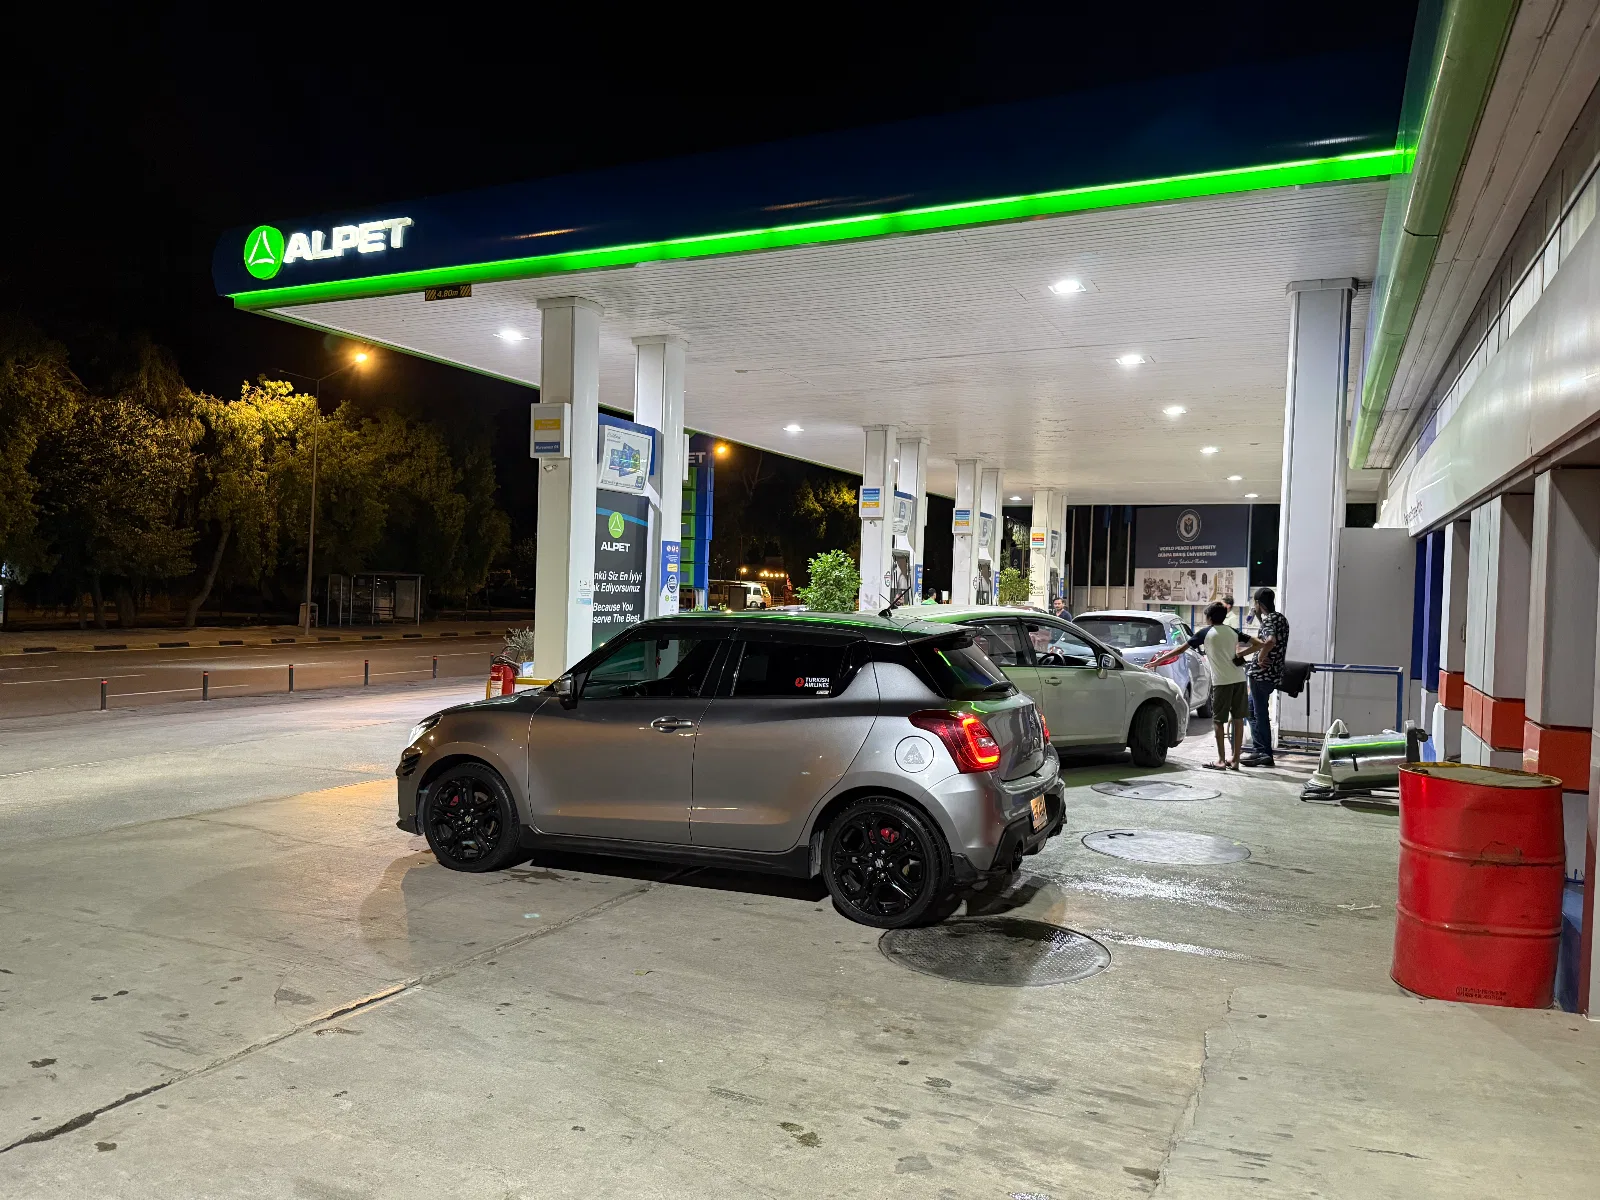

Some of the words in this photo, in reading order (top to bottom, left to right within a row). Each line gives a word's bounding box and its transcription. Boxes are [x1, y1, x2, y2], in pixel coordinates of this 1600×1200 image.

[282, 216, 414, 264] ALPET
[600, 541, 631, 552] ALPET
[594, 571, 607, 580] nkü
[608, 571, 618, 581] Siz
[619, 572, 628, 581] En
[601, 582, 641, 594] Ediyorsunuz
[593, 602, 620, 611] Because
[622, 602, 634, 611] You
[593, 615, 611, 624] serve
[613, 614, 624, 623] The
[625, 614, 640, 623] Best
